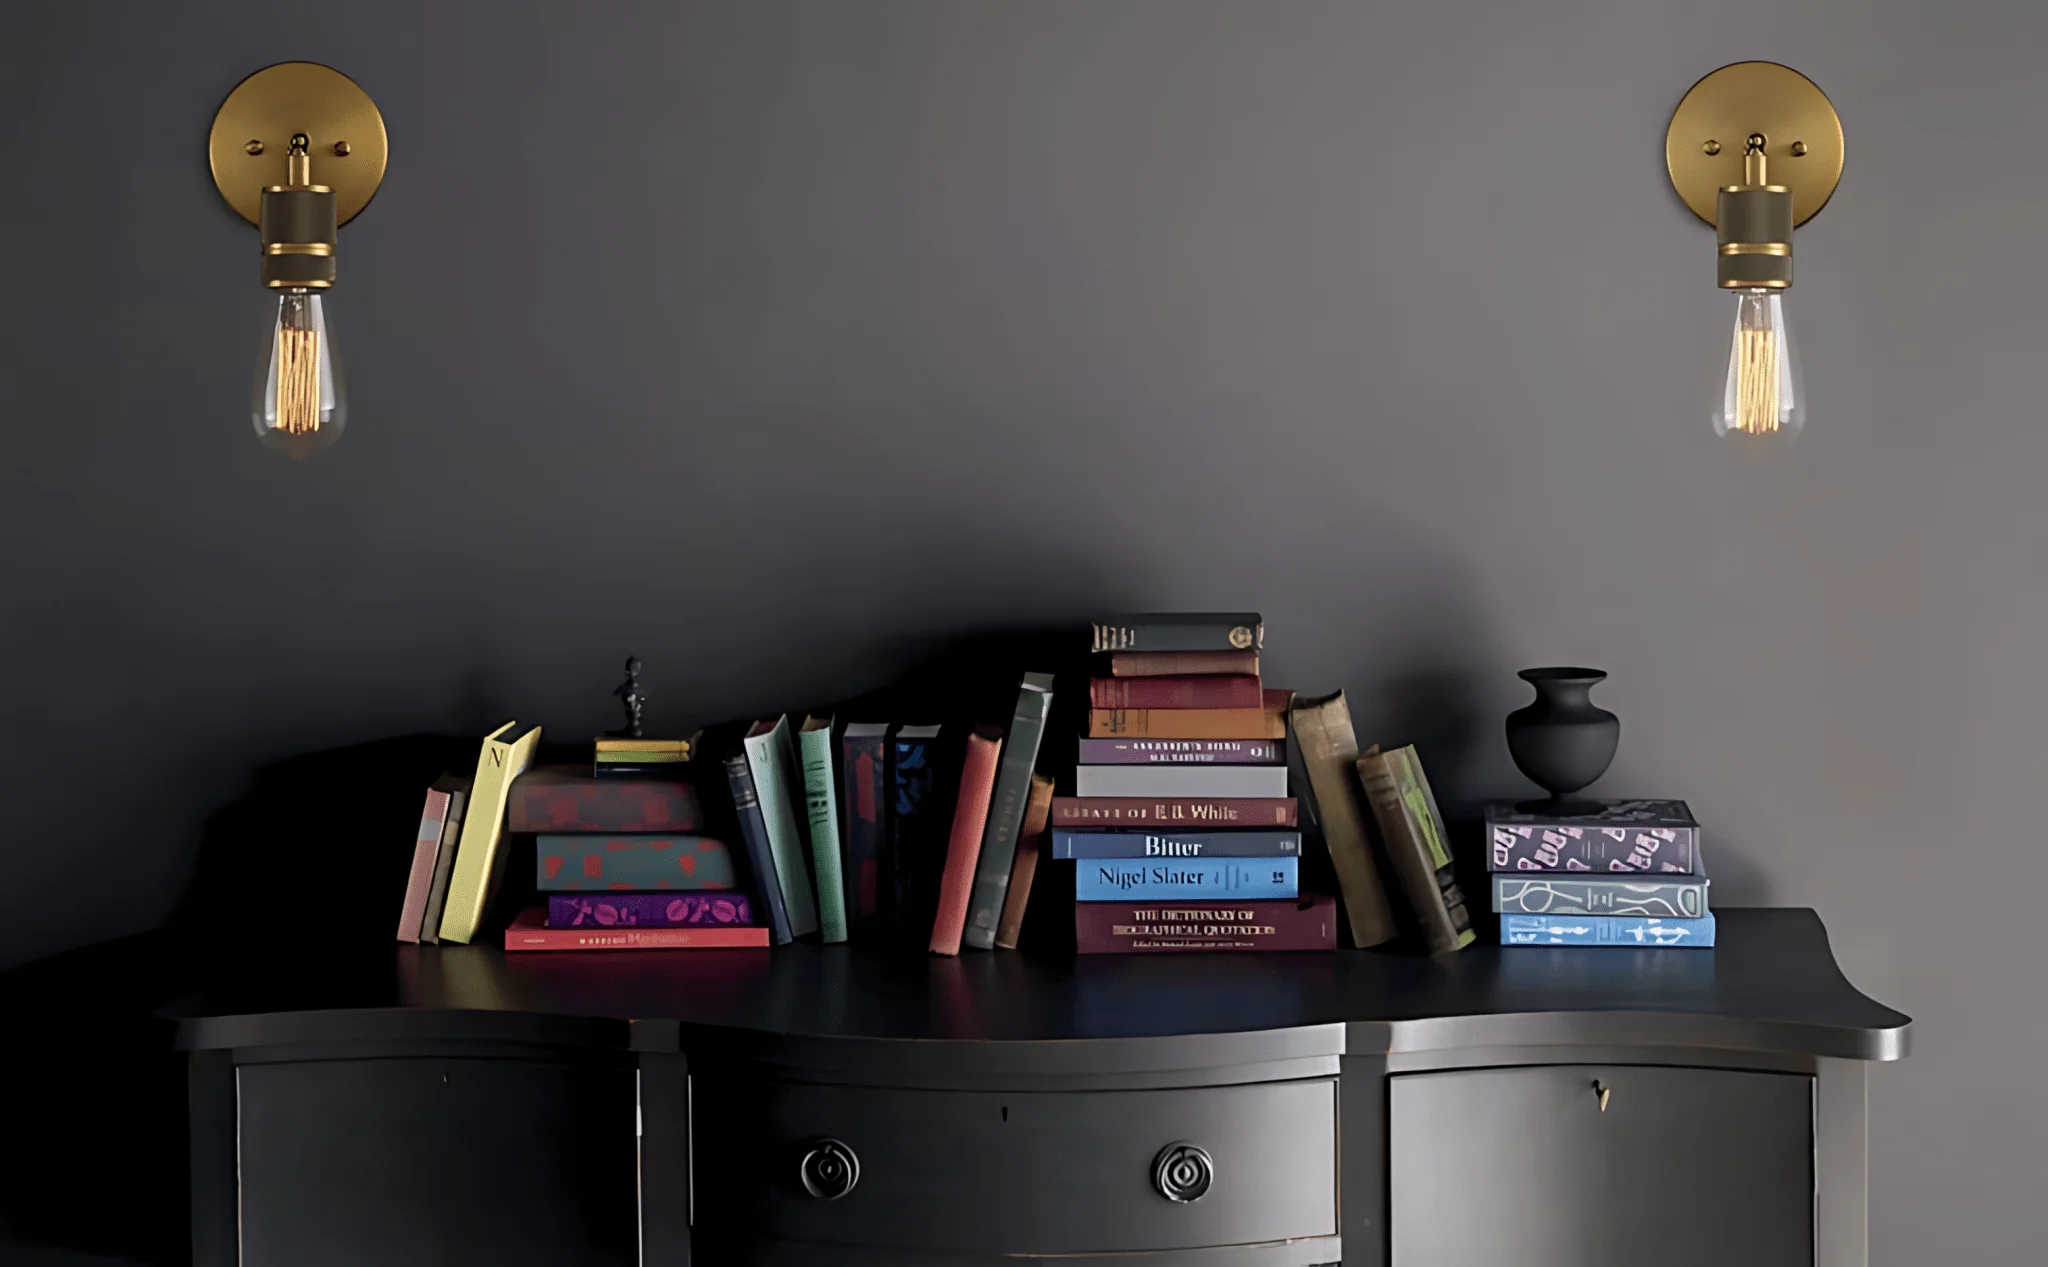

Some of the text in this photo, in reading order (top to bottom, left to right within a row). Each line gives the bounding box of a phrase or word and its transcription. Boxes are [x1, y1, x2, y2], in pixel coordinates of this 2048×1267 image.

[488, 747, 504, 768] N
[1190, 804, 1239, 820] White
[1144, 835, 1203, 857] Bitter
[1098, 866, 1146, 890] Nigel
[1152, 866, 1205, 885] Slater
[1237, 910, 1255, 921] OF
